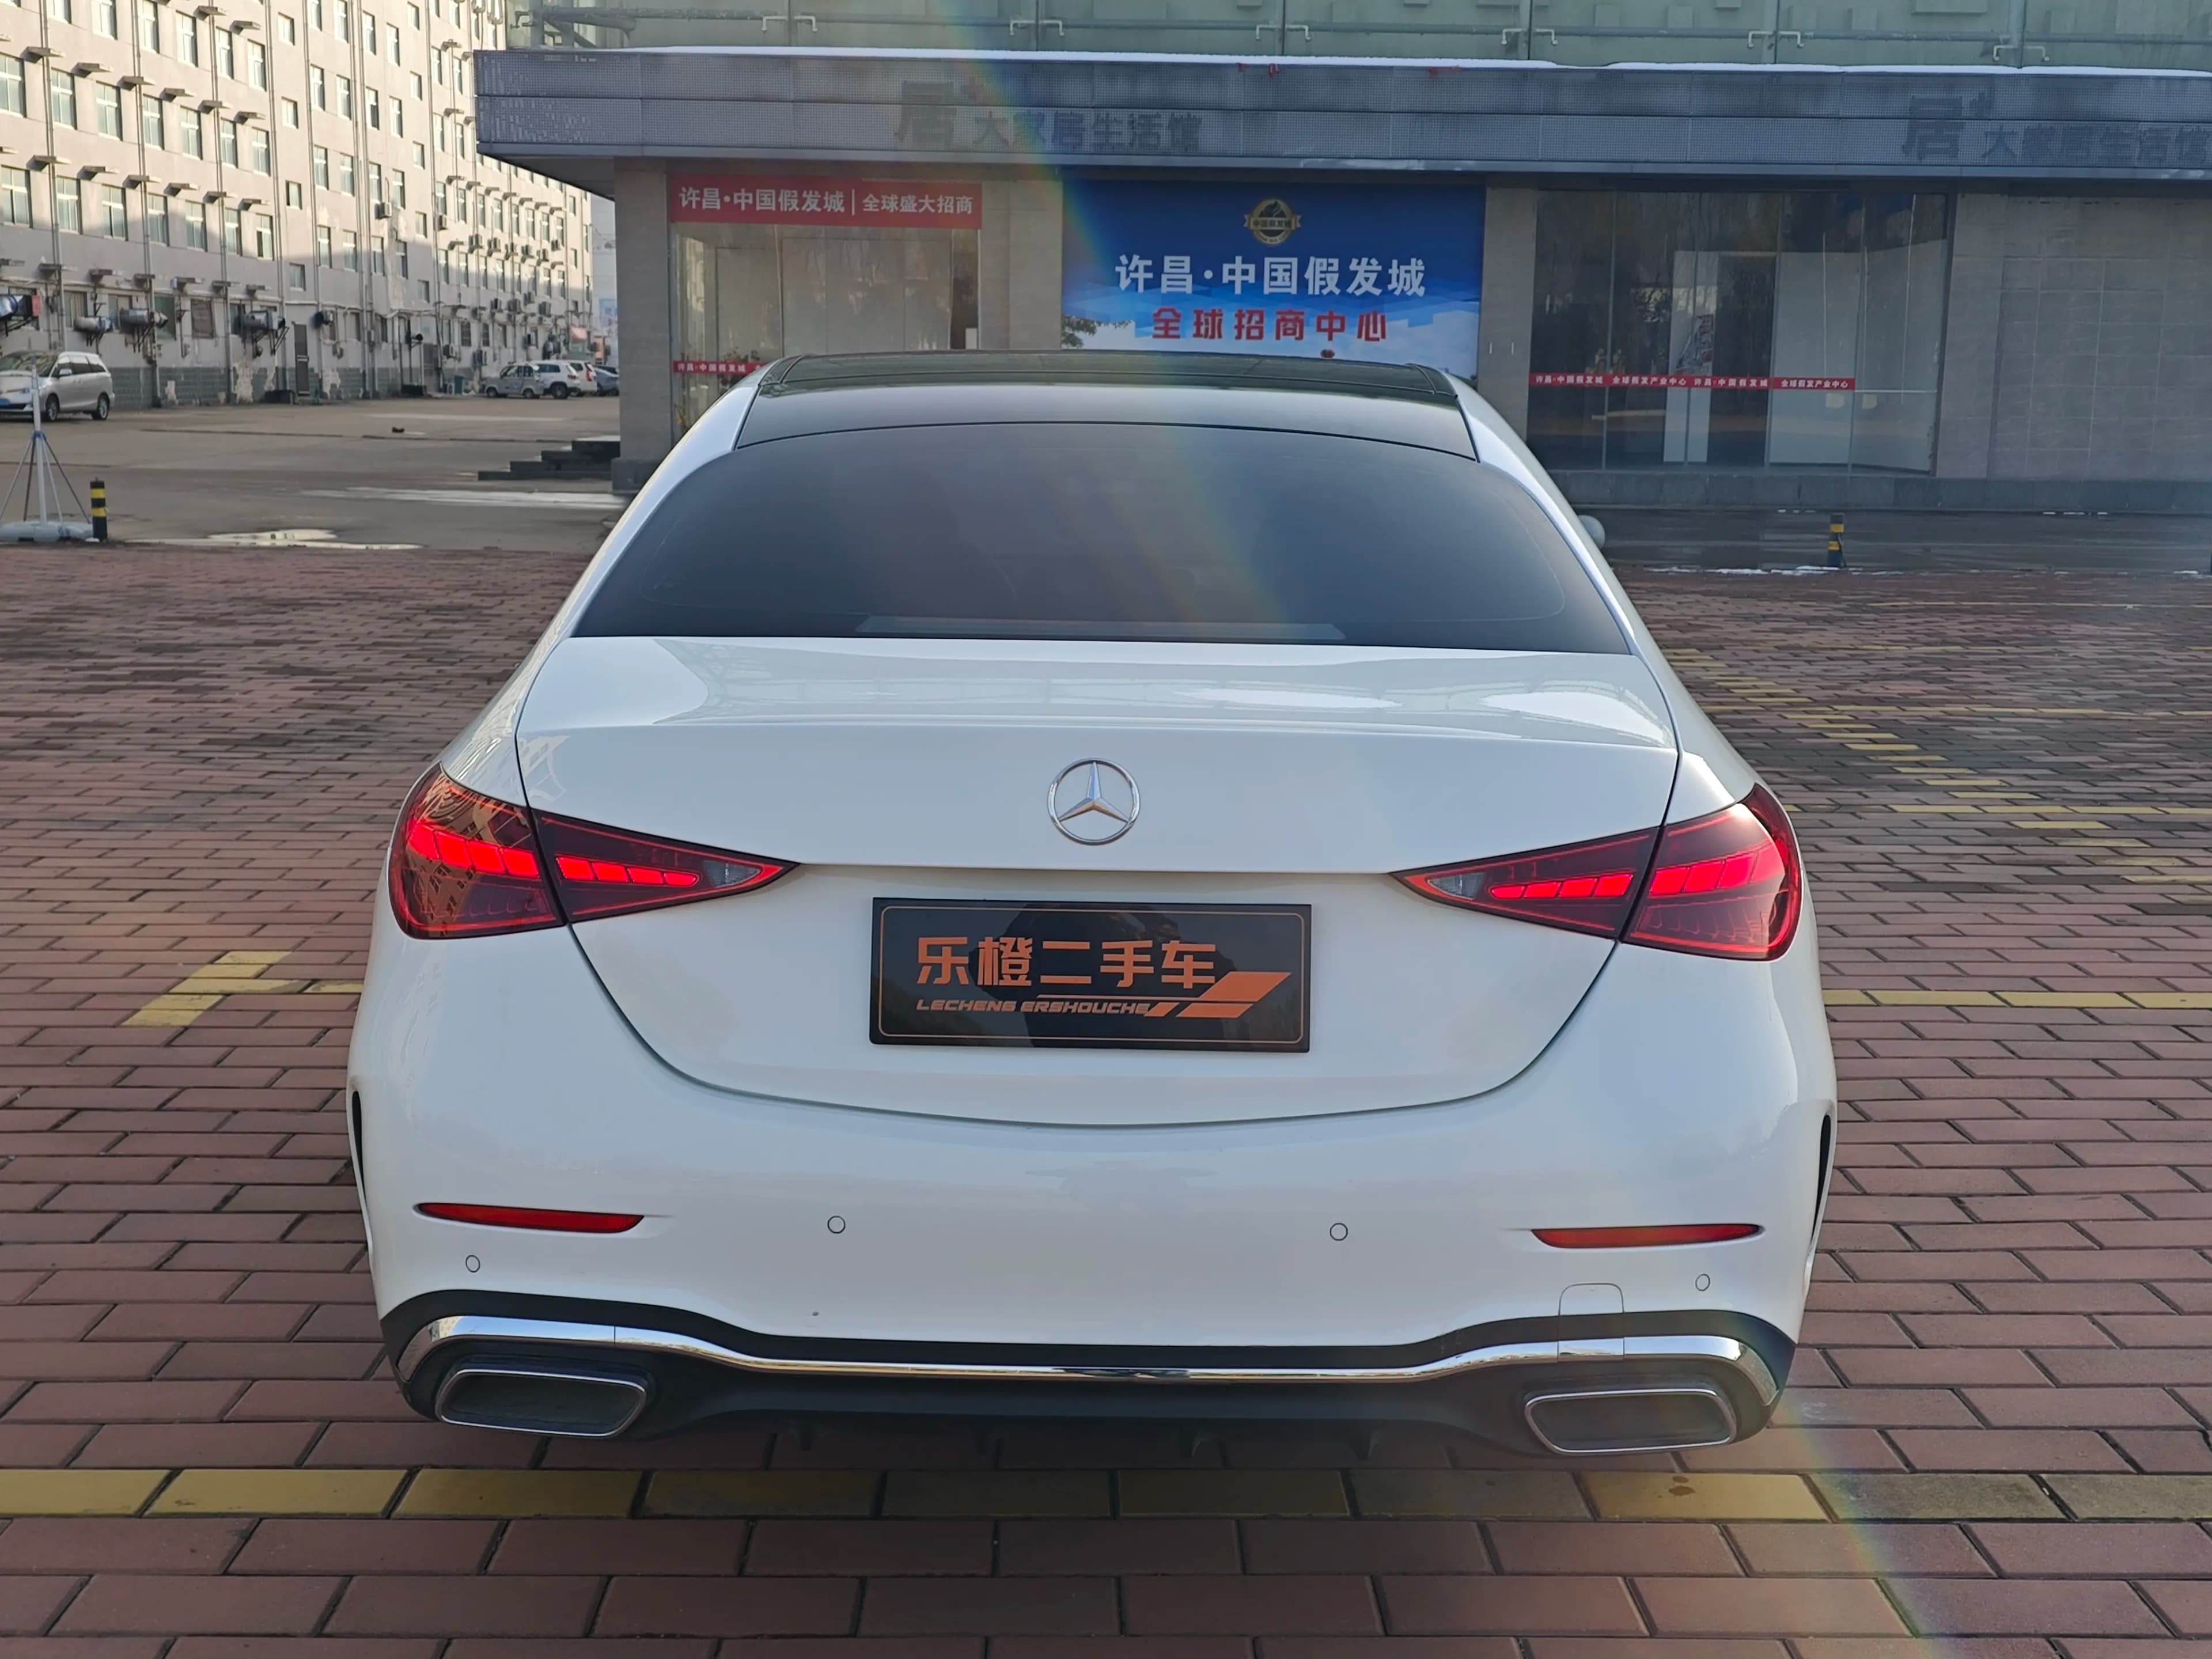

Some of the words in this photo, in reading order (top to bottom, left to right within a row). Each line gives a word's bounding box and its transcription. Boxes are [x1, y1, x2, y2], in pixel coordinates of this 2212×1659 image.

[679, 187, 845, 213] 许昌·中国假发城
[862, 194, 973, 215] 全球盛大招商
[1115, 254, 1426, 297] 许昌·中国假发城
[1152, 307, 1387, 342] 全球招商中心
[916, 937, 1217, 989] 乐橙二手车
[1020, 1001, 1152, 1014] ERSHOUCHE
